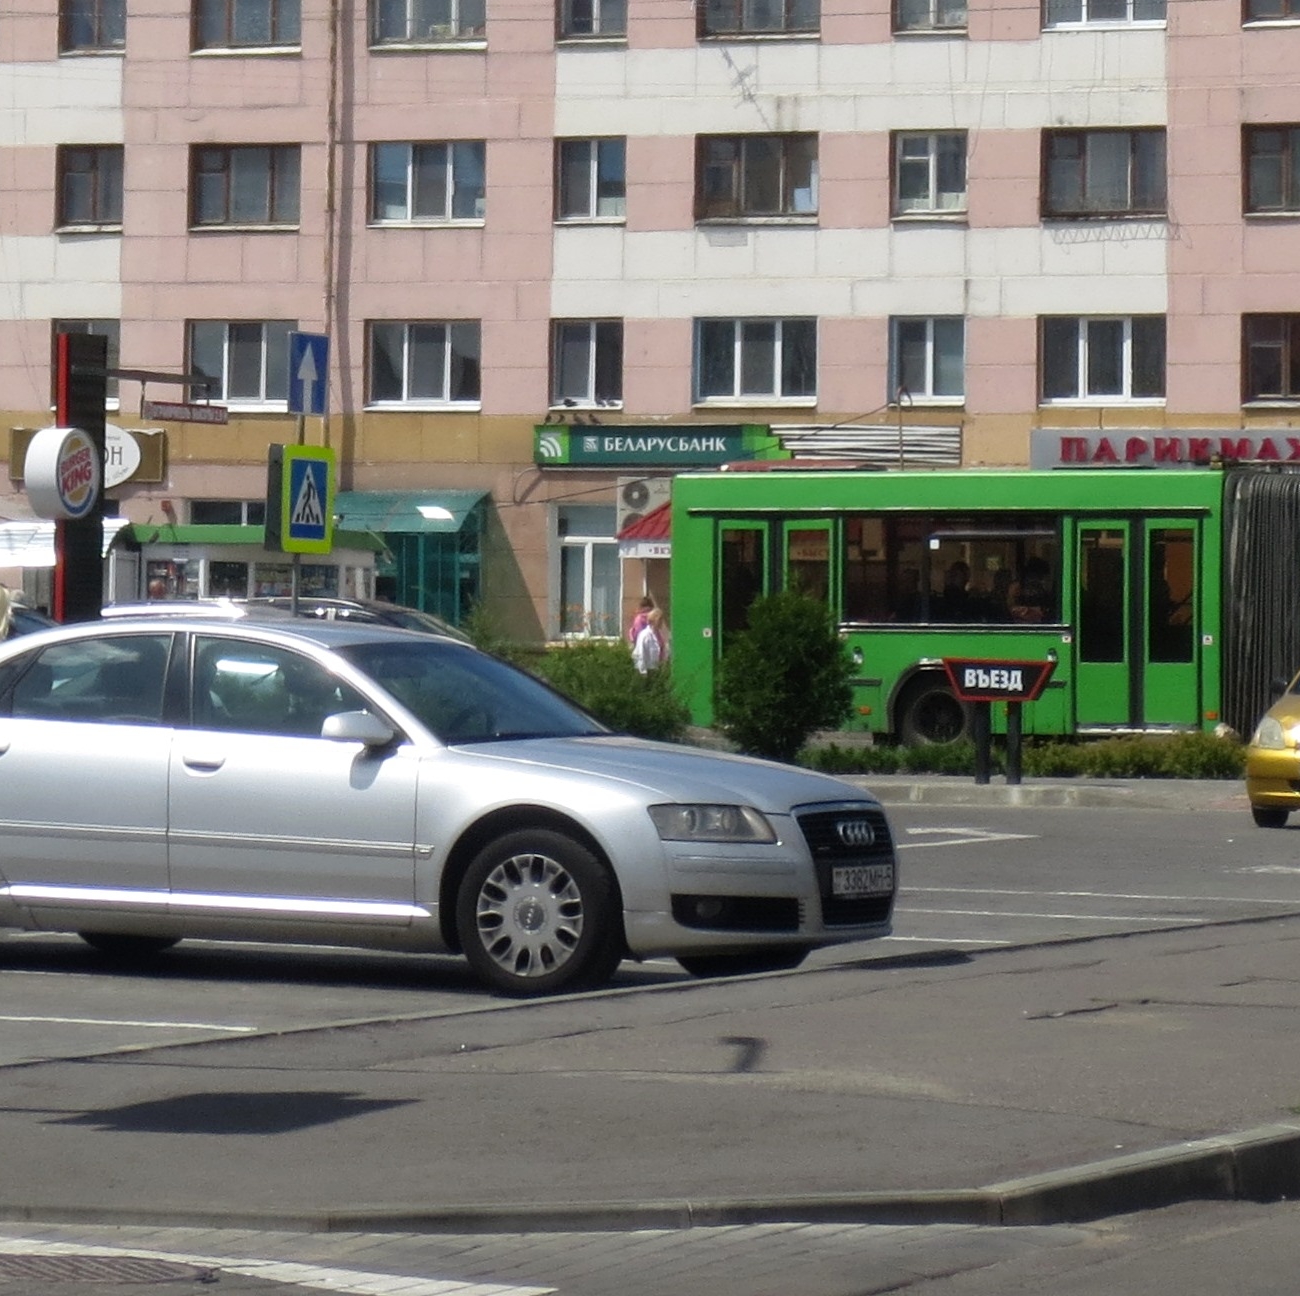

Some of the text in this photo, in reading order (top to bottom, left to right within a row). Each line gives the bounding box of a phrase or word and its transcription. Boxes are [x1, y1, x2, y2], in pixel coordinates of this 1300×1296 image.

[604, 436, 727, 452] БЕЛАРУСБАНК
[61, 446, 91, 475] BURGER
[62, 465, 92, 495] KING
[964, 669, 1023, 691] ВЪЕЗД
